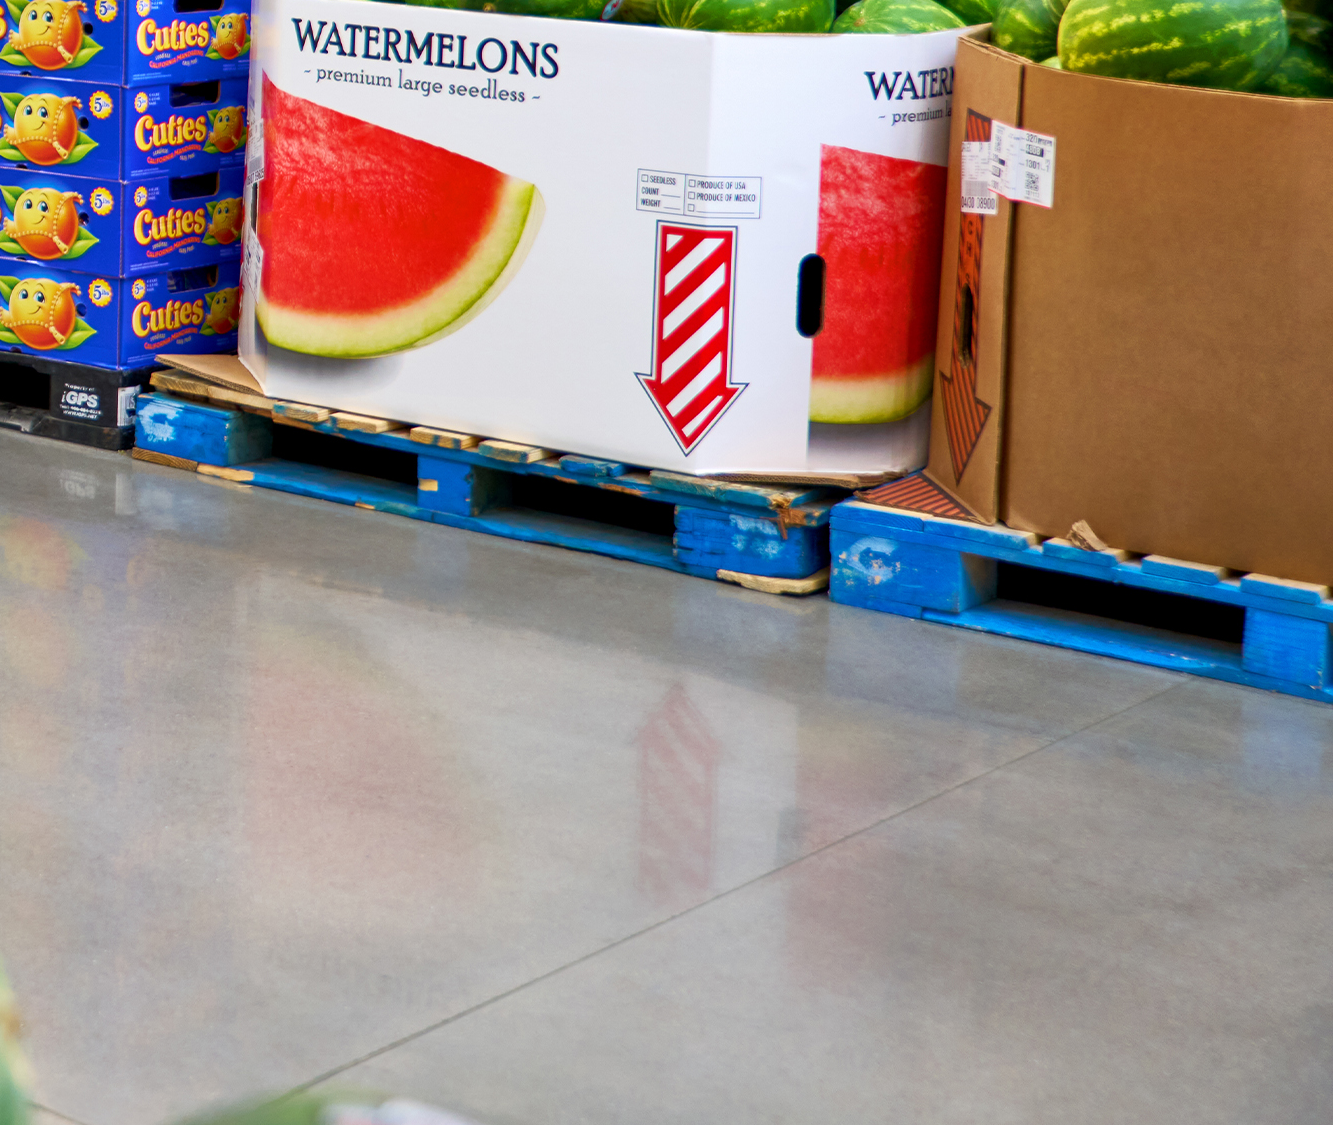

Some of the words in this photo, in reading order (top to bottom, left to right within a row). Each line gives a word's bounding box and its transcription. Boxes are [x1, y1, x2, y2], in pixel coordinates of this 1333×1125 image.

[291, 17, 560, 79] WATERMELONS
[316, 67, 393, 88] premium
[398, 68, 443, 97] large
[448, 79, 526, 103] seedless
[891, 106, 943, 126] premium
[649, 174, 677, 186] SEEDLESS
[696, 180, 724, 190] PRODUCE
[725, 181, 733, 190] OF
[734, 181, 746, 190] USA
[641, 186, 659, 196] COUNT
[640, 197, 661, 208] WEIGHT
[696, 192, 724, 202] PRODUCE
[724, 193, 733, 202] OF
[733, 193, 756, 203] MEXICO
[61, 390, 99, 408] iGPS
